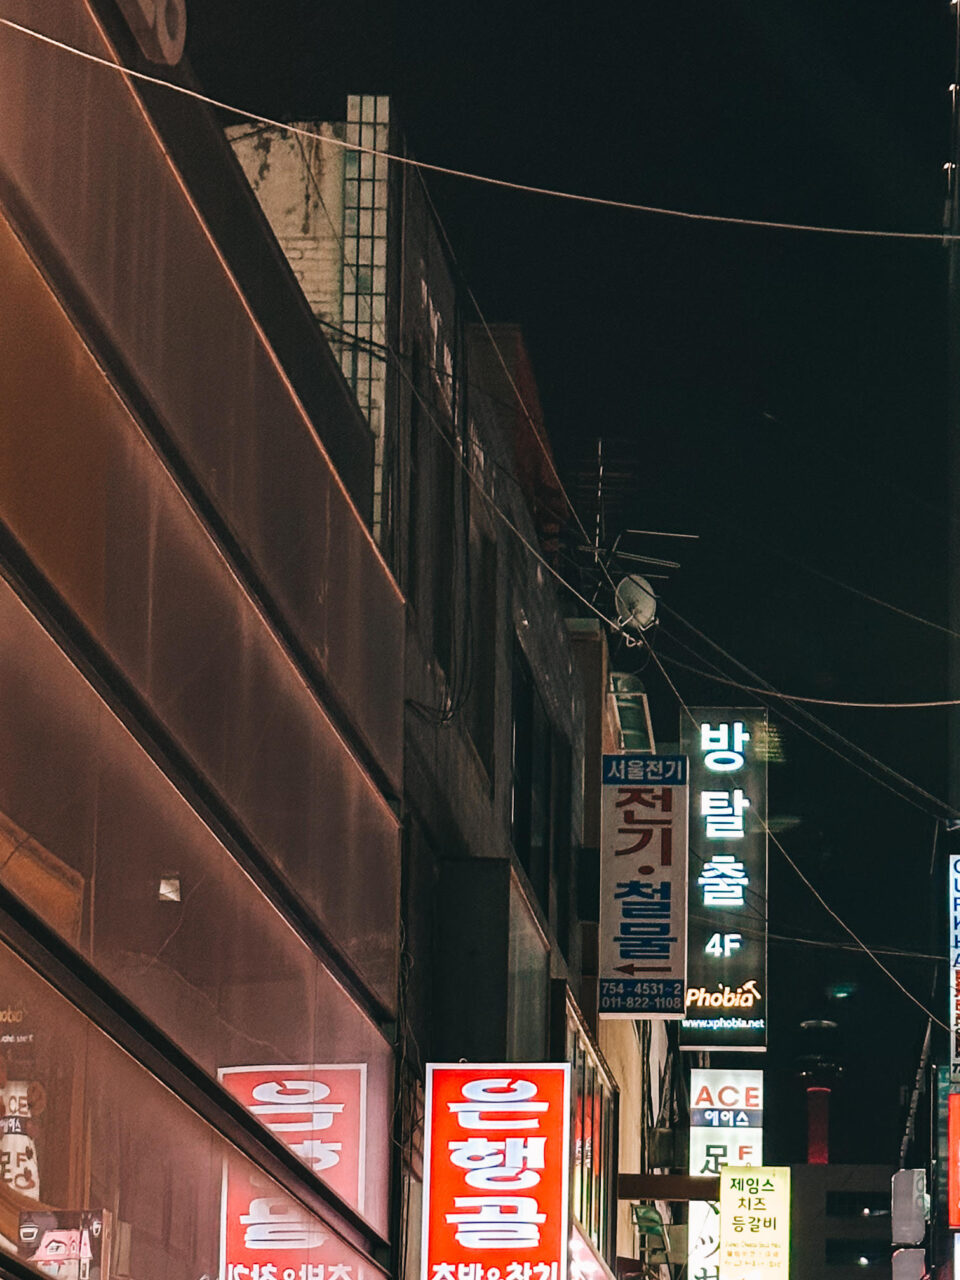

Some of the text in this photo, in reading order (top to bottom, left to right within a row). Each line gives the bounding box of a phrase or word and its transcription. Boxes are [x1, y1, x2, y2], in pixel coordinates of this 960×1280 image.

[607, 760, 682, 781] 서울전기
[698, 722, 750, 906] 방탈출
[705, 933, 742, 957] 4F
[602, 997, 681, 1010] 011-822-1108
[686, 984, 754, 1008] Phobia
[682, 1016, 764, 1030] www.xphobia.net
[695, 1085, 760, 1107] ACE
[704, 1110, 749, 1127] 에이스
[445, 1077, 549, 1249] 은행골
[730, 1178, 775, 1195] 제임스
[738, 1197, 767, 1211] 치즈
[732, 1216, 777, 1233] 등갈비
